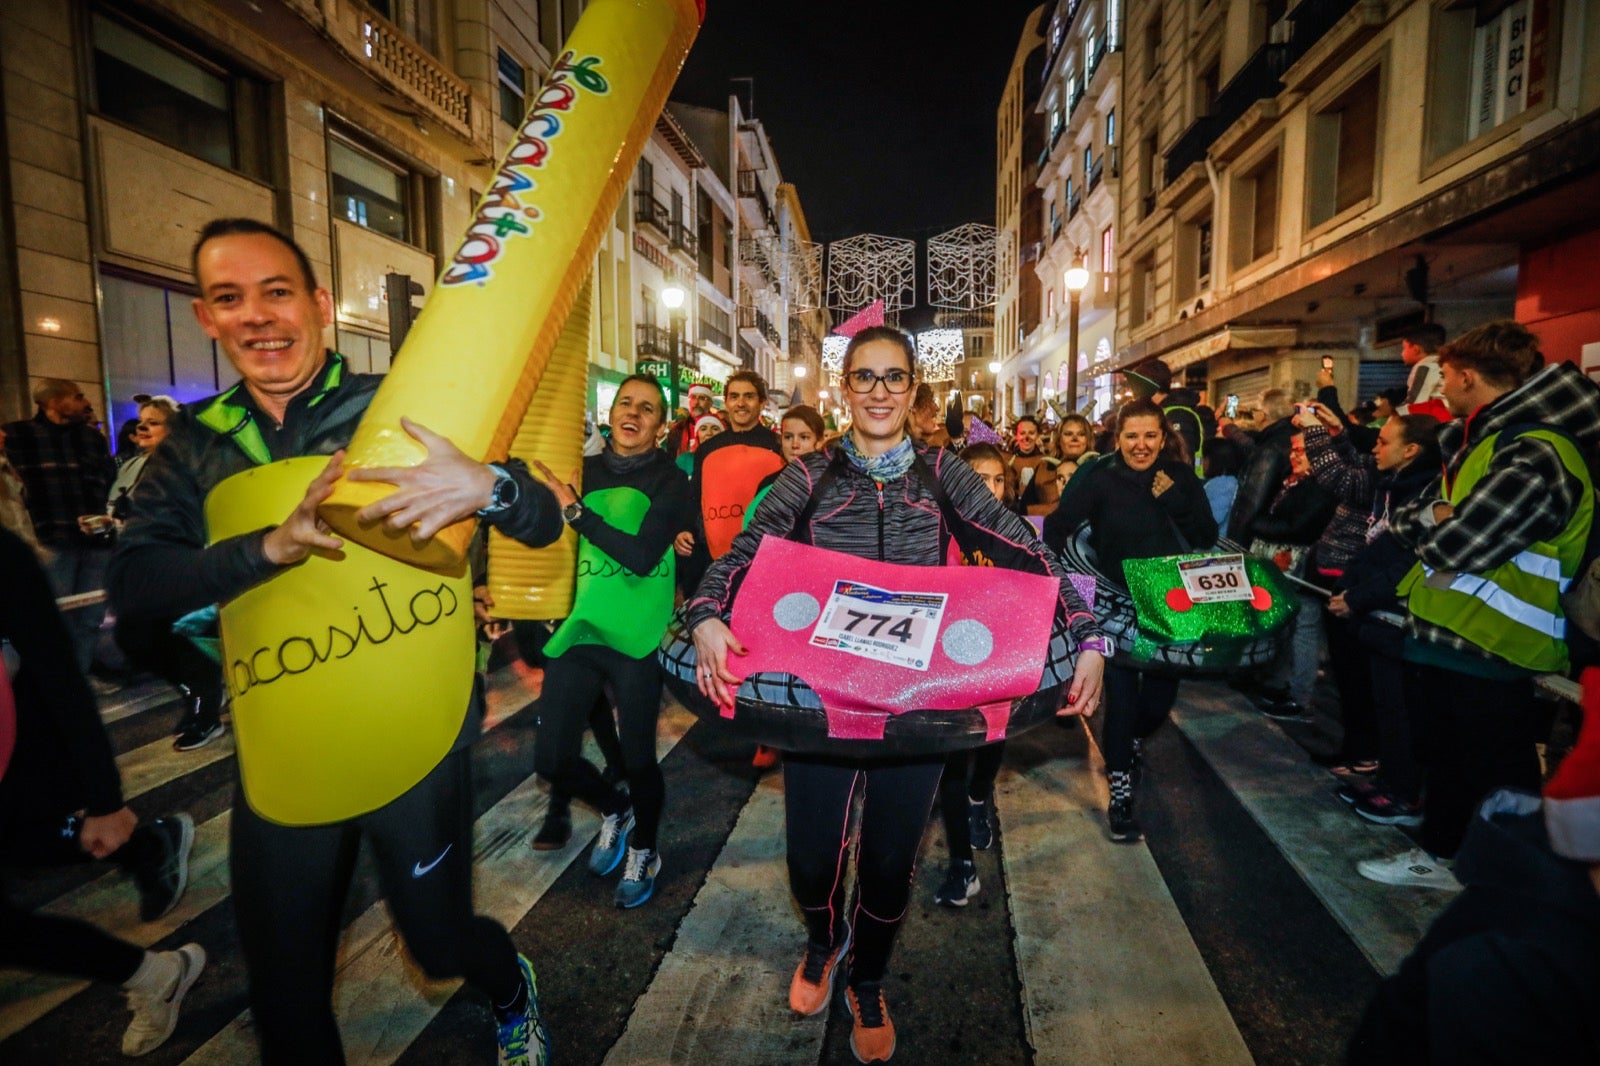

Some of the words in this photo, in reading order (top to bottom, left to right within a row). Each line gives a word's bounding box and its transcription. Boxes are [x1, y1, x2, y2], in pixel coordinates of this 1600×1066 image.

[1198, 572, 1239, 590] 630
[227, 576, 458, 702] acasitos
[844, 608, 915, 643] 774
